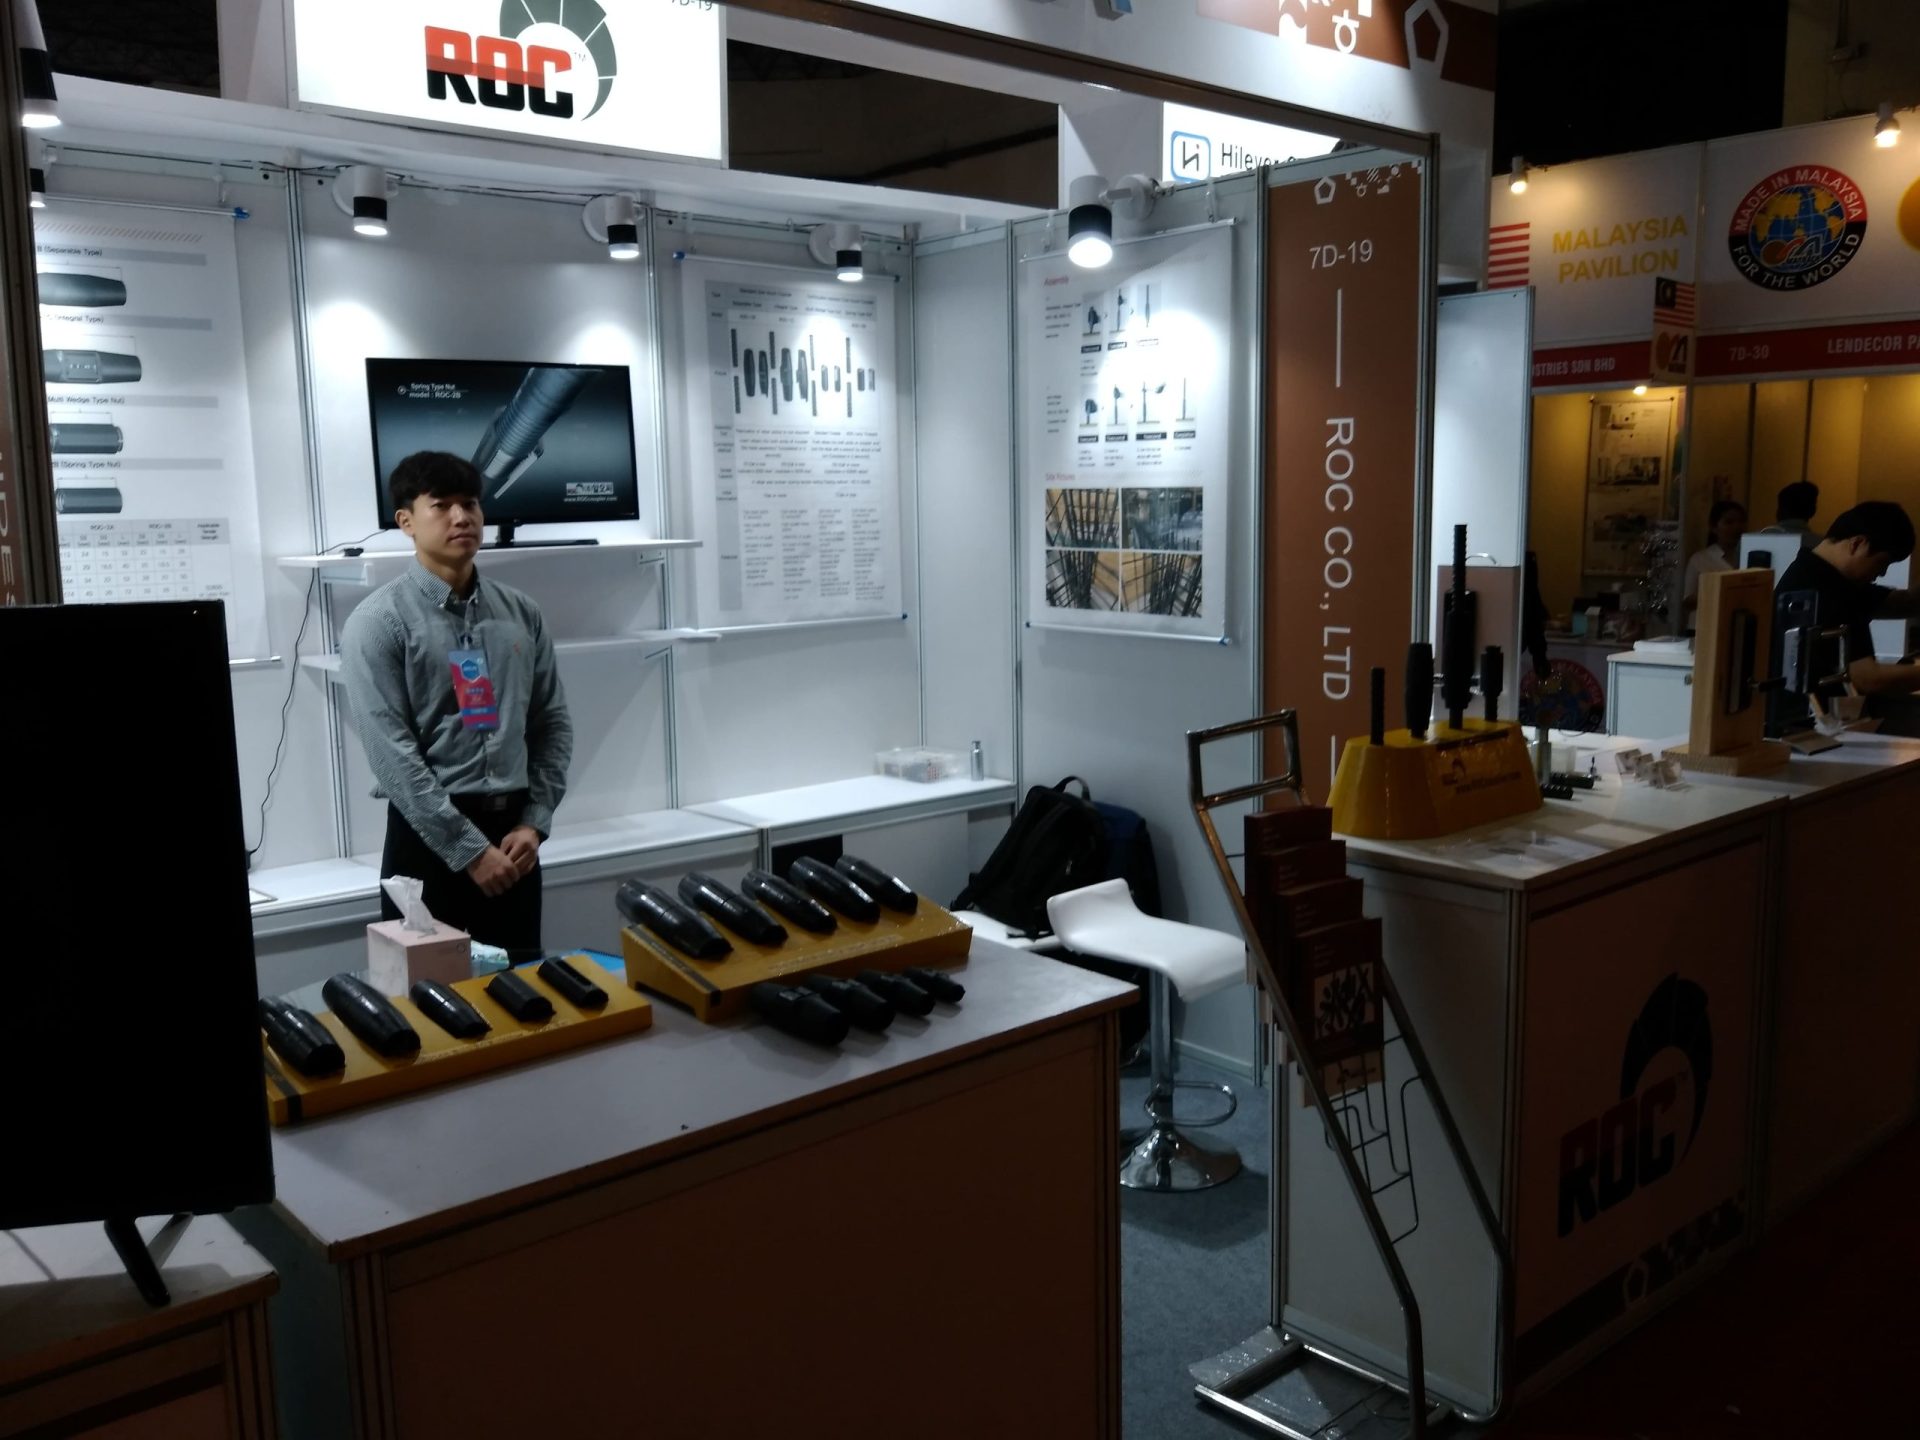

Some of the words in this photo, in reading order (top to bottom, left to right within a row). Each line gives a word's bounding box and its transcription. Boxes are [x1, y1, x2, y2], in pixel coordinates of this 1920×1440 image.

[424, 25, 574, 119] ROC
[1735, 186, 1770, 231] MADE
[1772, 174, 1789, 191] IN
[1795, 169, 1863, 219] MALAYSIA
[1552, 214, 1688, 254] MALAYSIA
[1308, 239, 1374, 270] 7D-19
[1558, 248, 1679, 283] PAVILION
[1733, 244, 1760, 277] FOR
[1762, 270, 1797, 289] THE
[1802, 233, 1860, 285] WORLD
[1730, 344, 1770, 362] 7D-30
[1827, 335, 1903, 355] LENDECOR
[1532, 360, 1569, 377] STRIES
[1594, 356, 1616, 373] BHD
[409, 391, 430, 399] model
[431, 383, 445, 391] Type
[1325, 416, 1355, 513] ROC
[1318, 526, 1353, 610] CO.,
[1322, 625, 1352, 700] LTD
[1558, 1076, 1676, 1237] ROC
